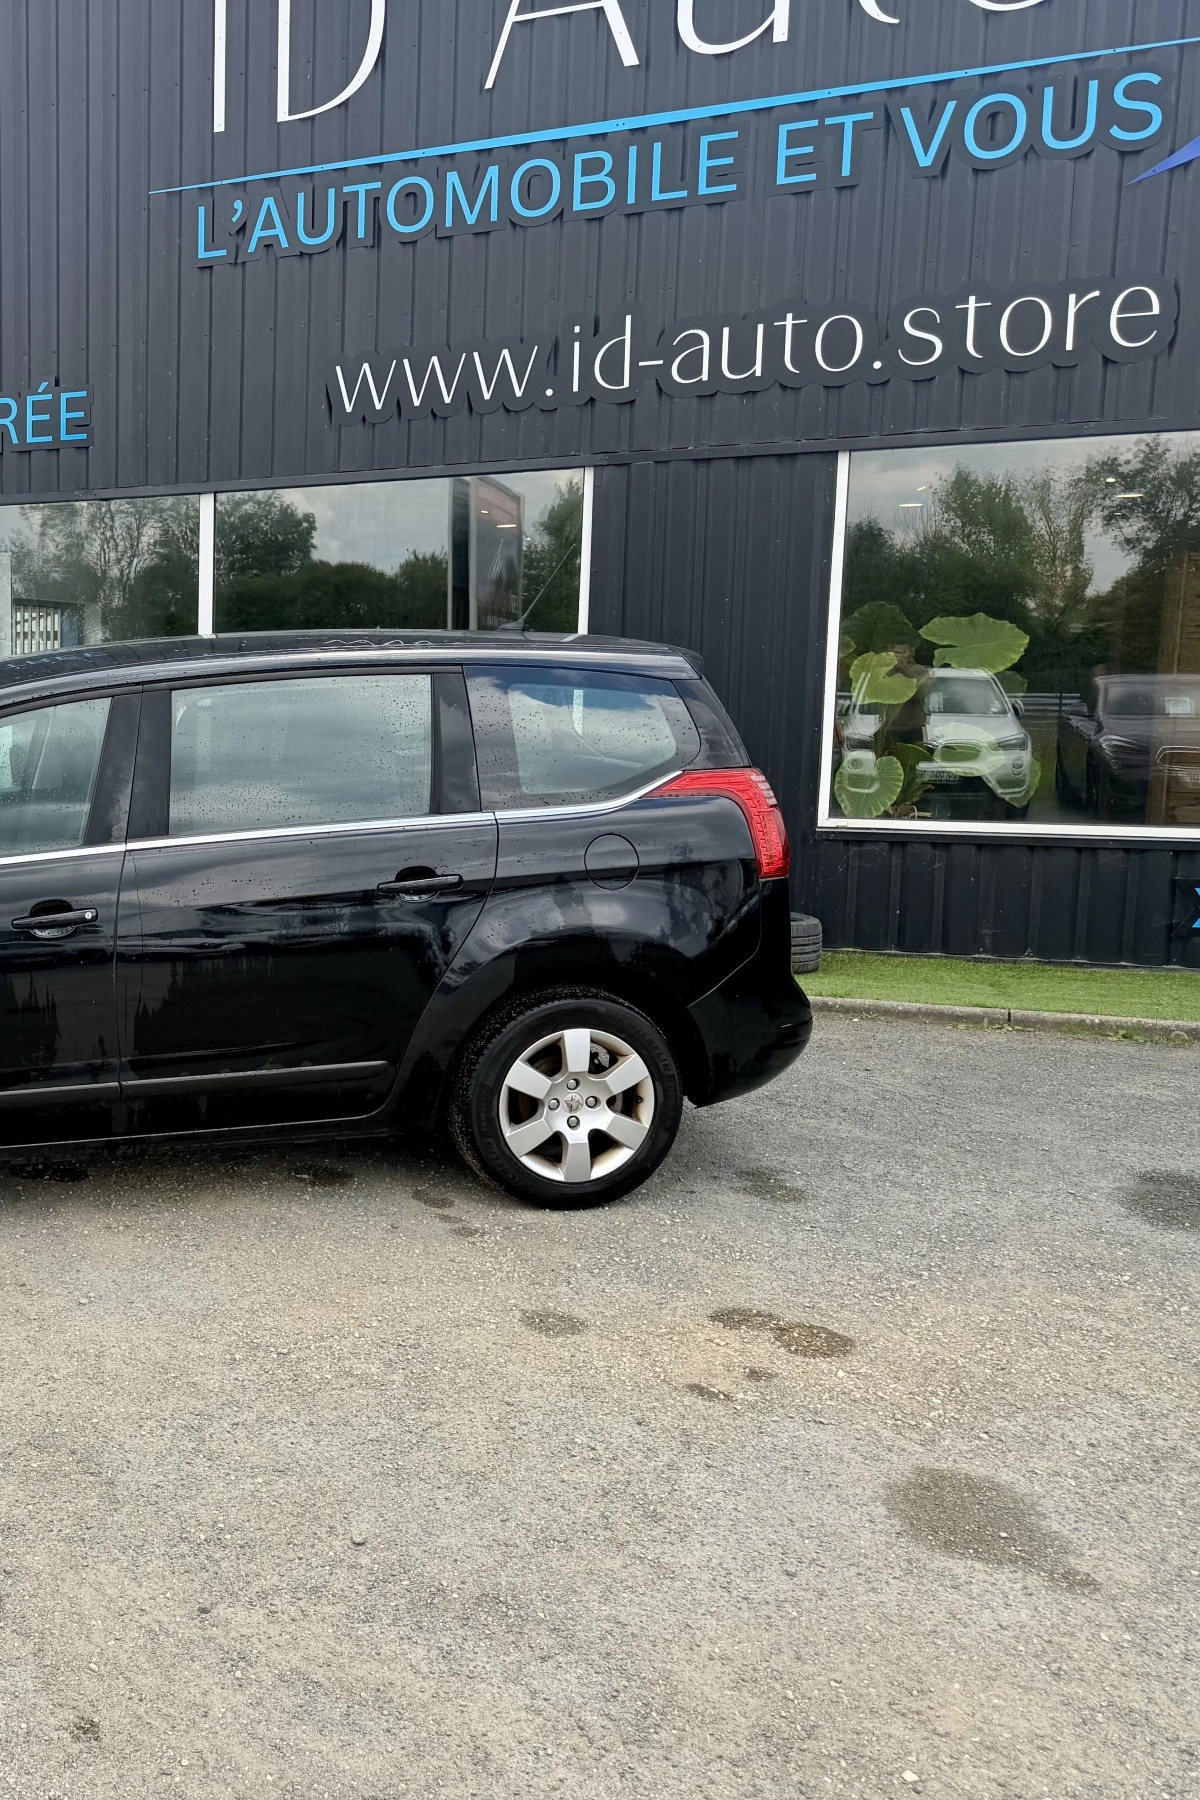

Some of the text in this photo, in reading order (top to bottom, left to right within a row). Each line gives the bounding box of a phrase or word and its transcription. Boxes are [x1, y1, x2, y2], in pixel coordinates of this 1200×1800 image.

[776, 111, 874, 186] ET
[900, 70, 1165, 169] VOUS
[335, 286, 1161, 413] www.id-auto.store
